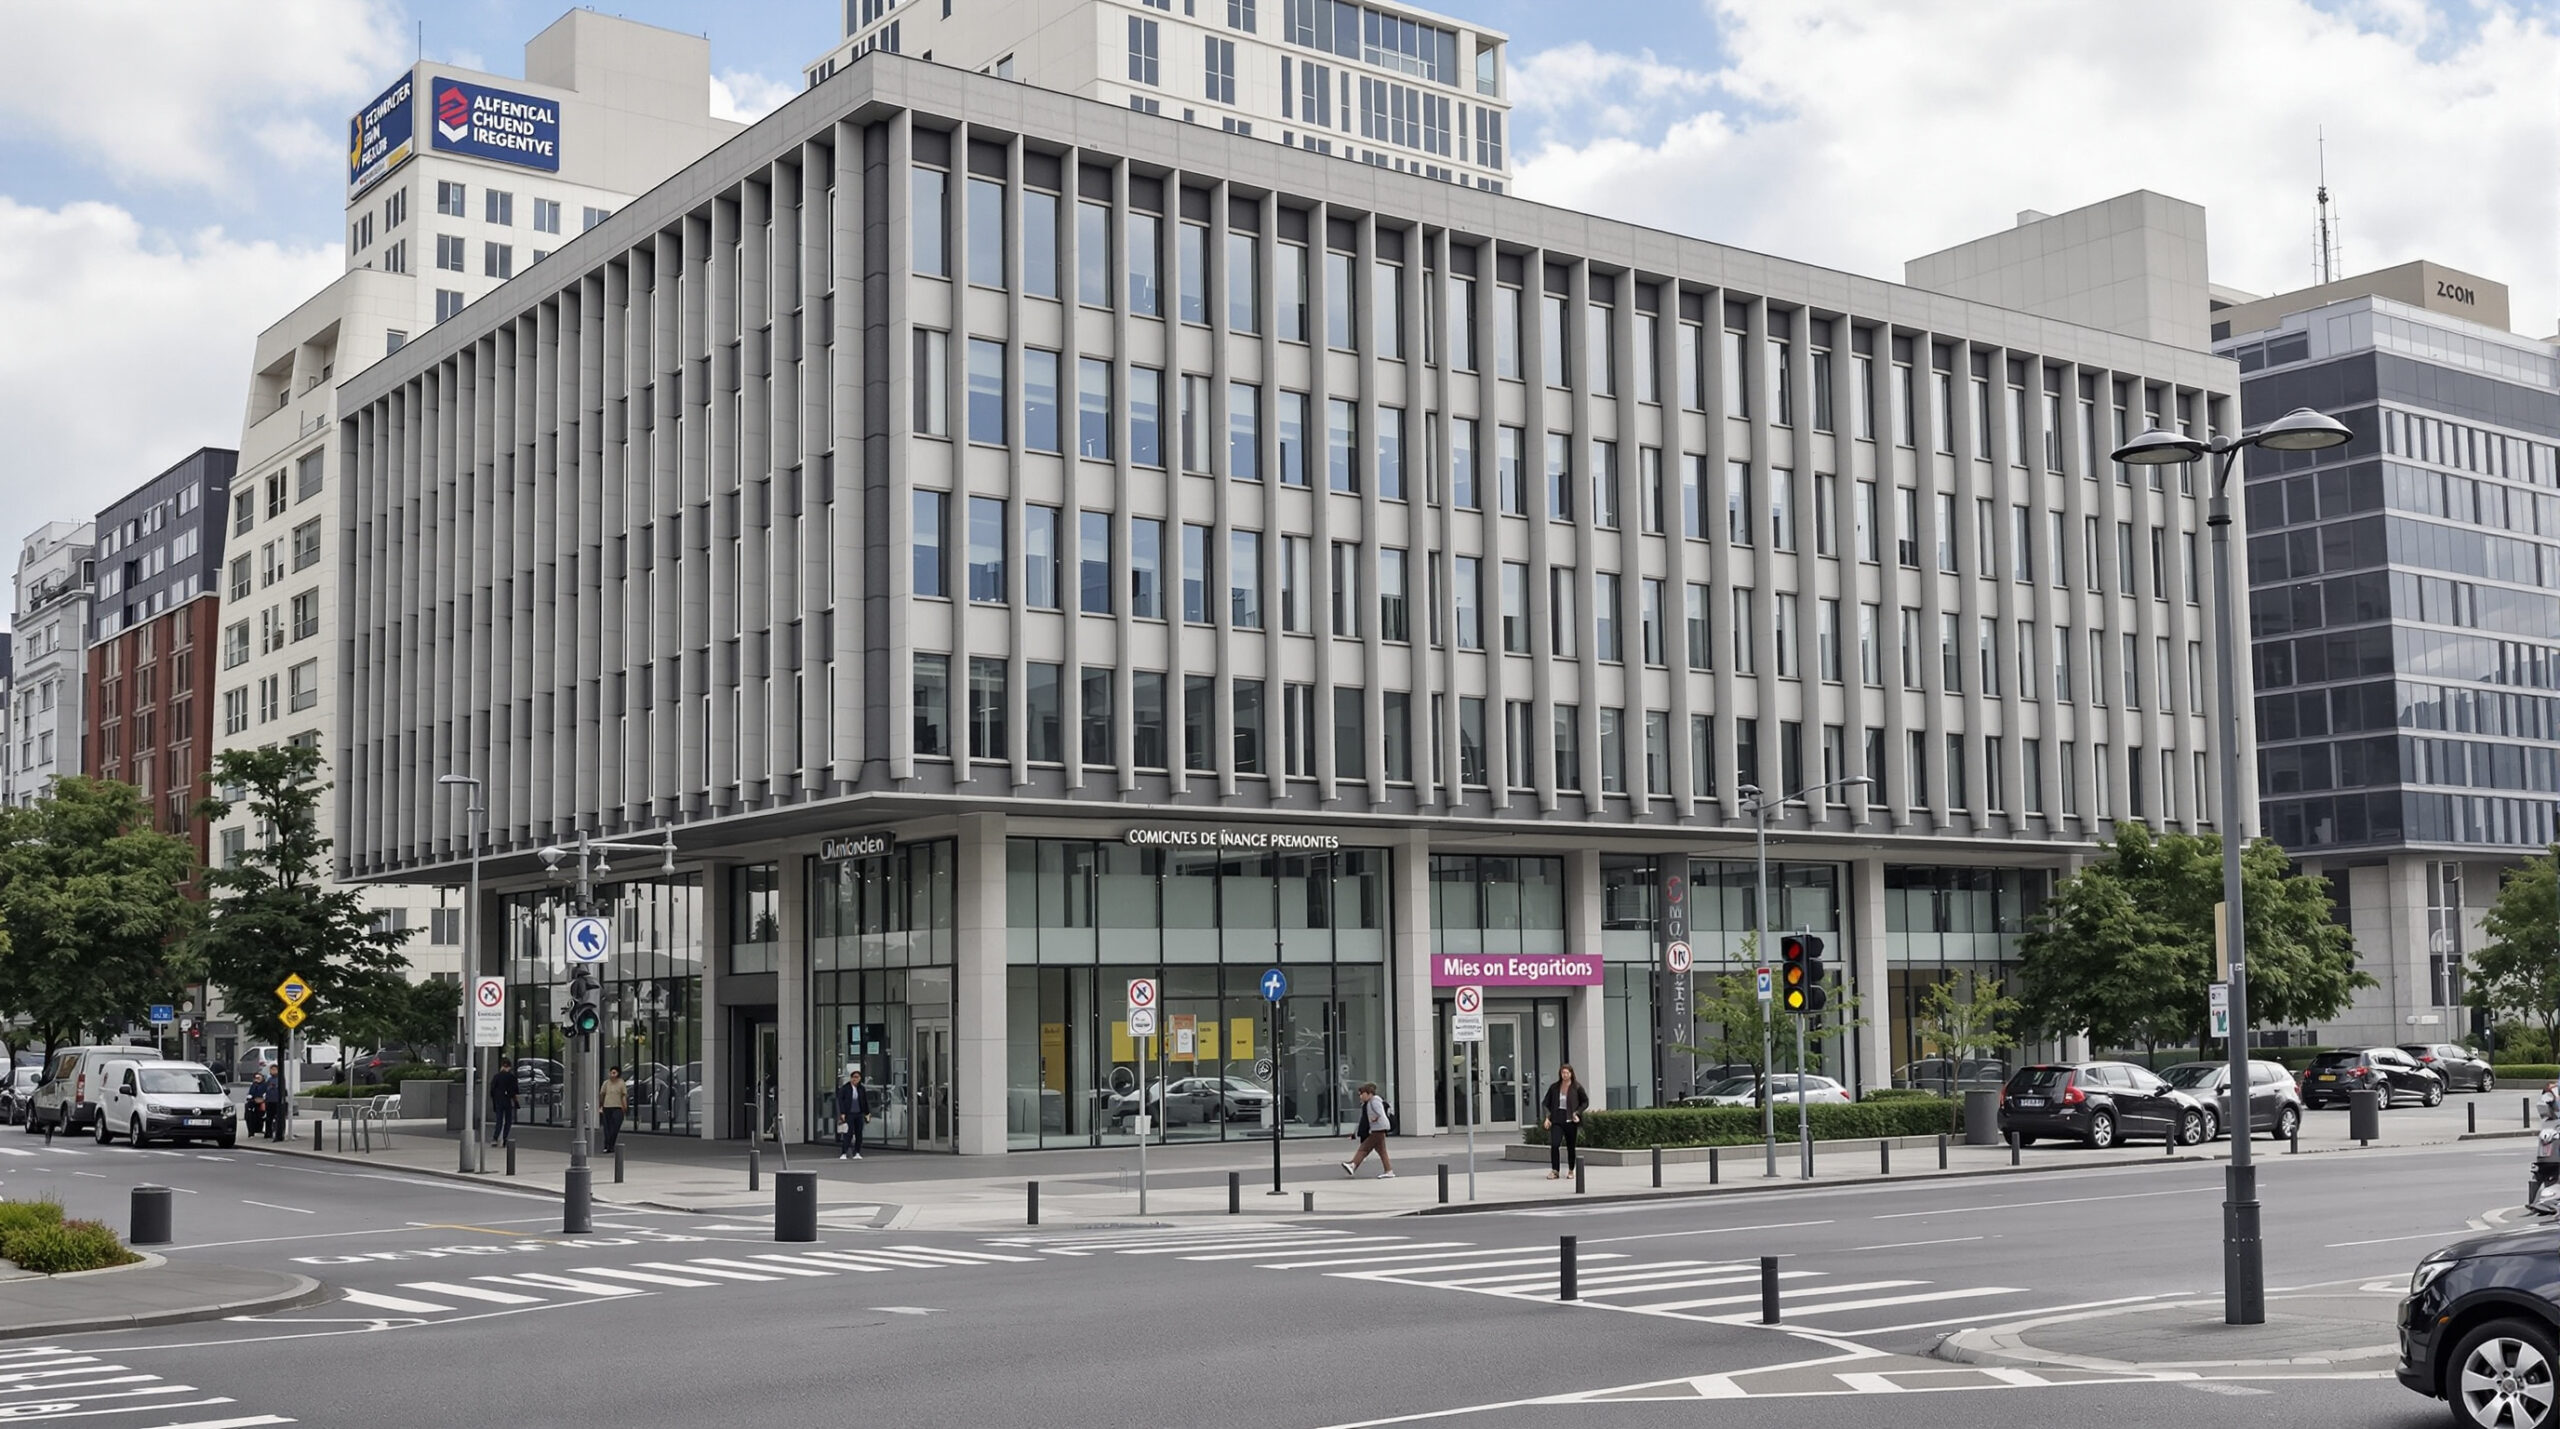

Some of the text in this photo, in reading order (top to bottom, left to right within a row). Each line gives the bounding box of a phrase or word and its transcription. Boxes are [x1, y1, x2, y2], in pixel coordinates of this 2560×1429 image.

[472, 111, 535, 136] CHUEND
[1200, 831, 1217, 846] DE
[1444, 958, 1481, 977] Mies
[1483, 962, 1504, 977] on
